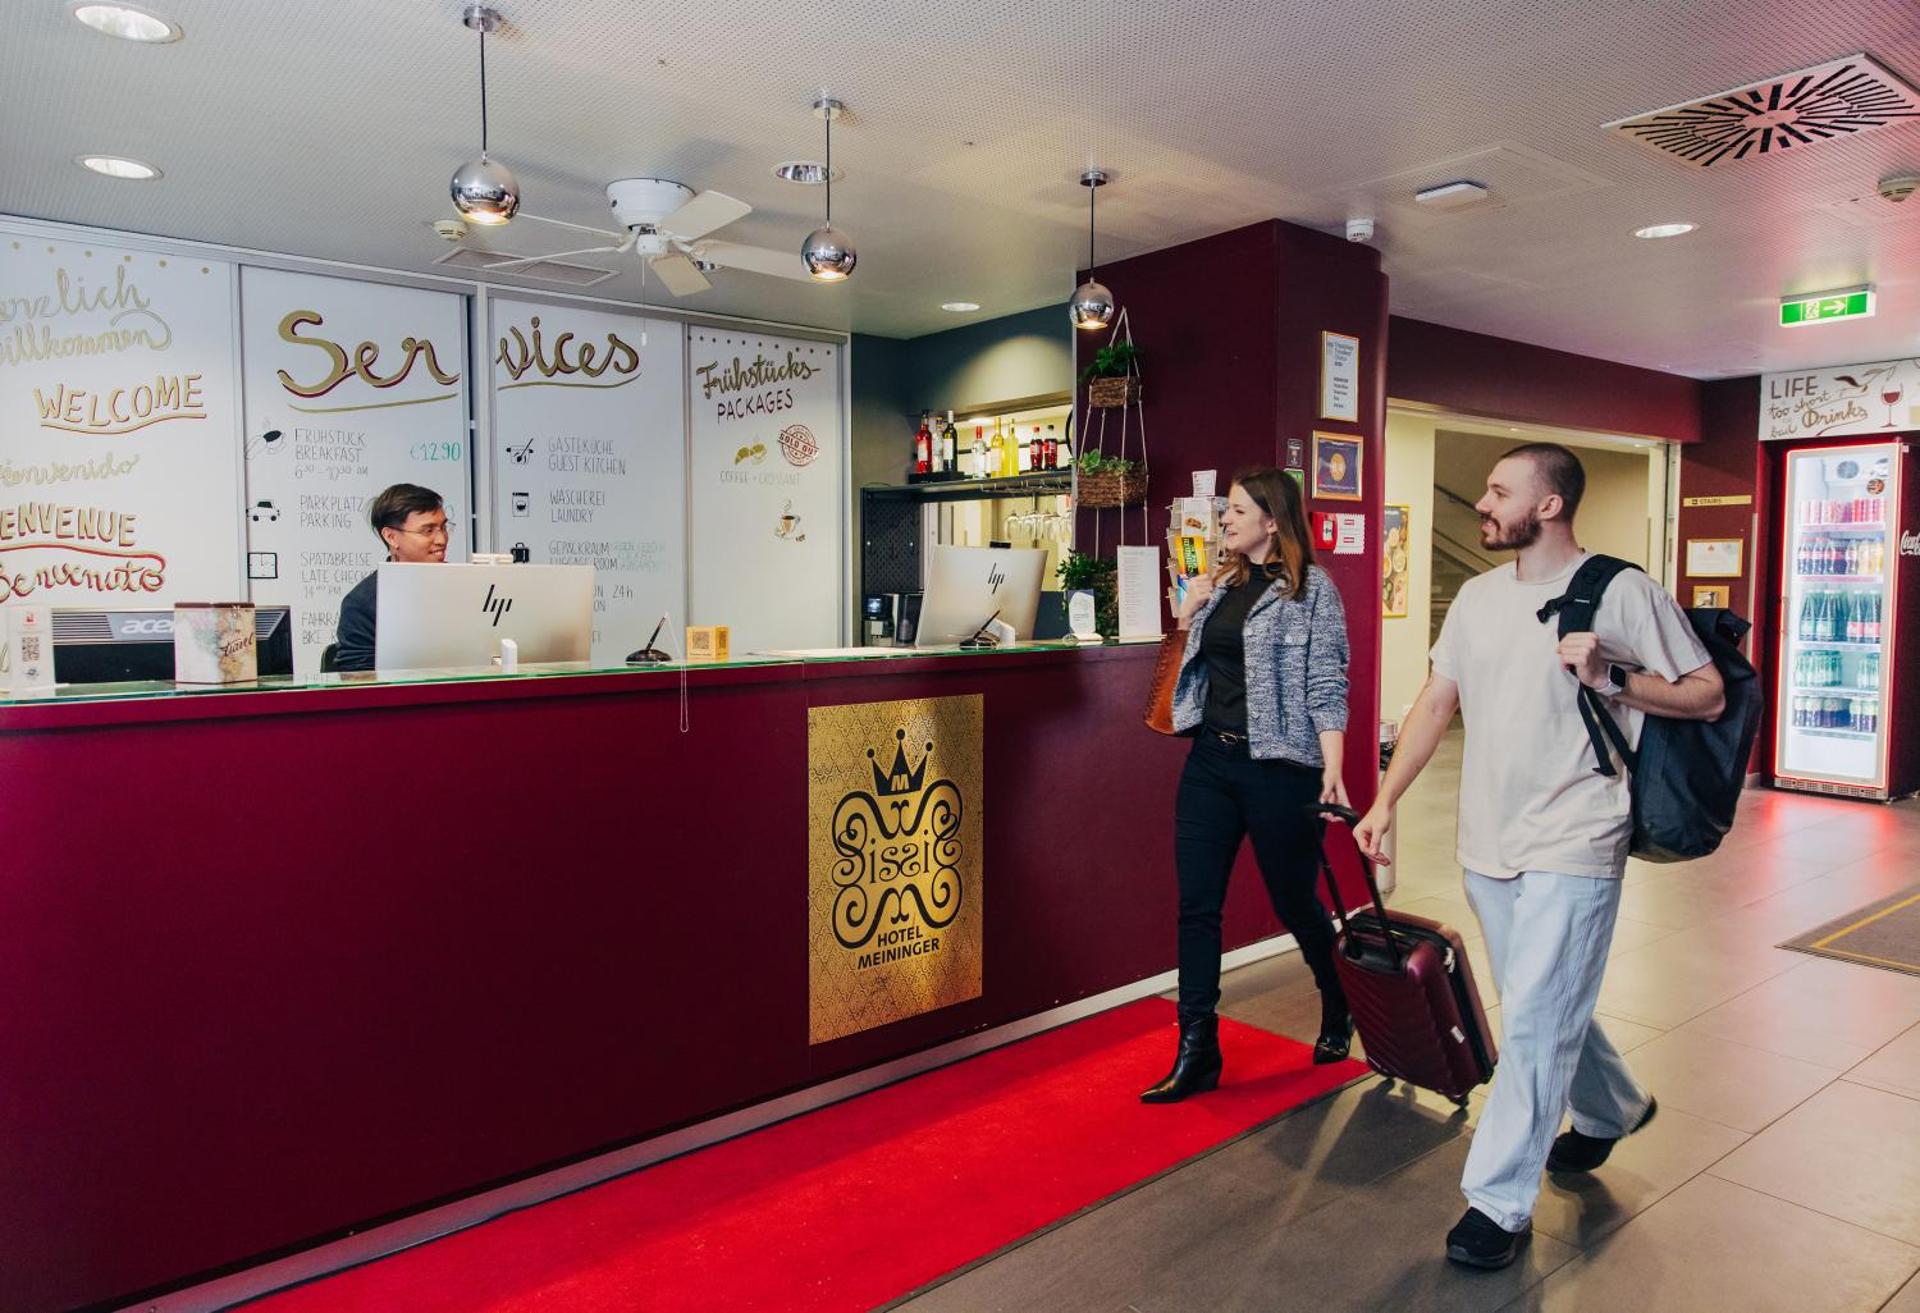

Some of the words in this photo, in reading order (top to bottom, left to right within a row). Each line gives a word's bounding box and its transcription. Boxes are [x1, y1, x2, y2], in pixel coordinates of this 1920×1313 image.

[496, 316, 640, 381] vices
[1770, 375, 1819, 400] LIFE
[34, 373, 204, 427] WELCOME
[717, 388, 794, 424] PACKAGES
[1793, 389, 1831, 414] short
[1801, 400, 1869, 429] Drinks
[780, 432, 801, 449] SOLD
[295, 444, 364, 464] BREAKFAST
[548, 453, 581, 473] GUEST
[584, 456, 627, 476] KITCHEN
[300, 495, 365, 513] PARKPLATZ
[551, 508, 594, 524] LAUNDRY
[300, 511, 352, 529] PARKING
[593, 555, 619, 571] ROOM
[301, 568, 330, 586] LATE
[333, 569, 375, 586] CHECK
[988, 562, 1006, 595] hp
[482, 584, 513, 627] hp
[877, 925, 923, 948] HOTEL
[857, 938, 941, 970] MEININGER
